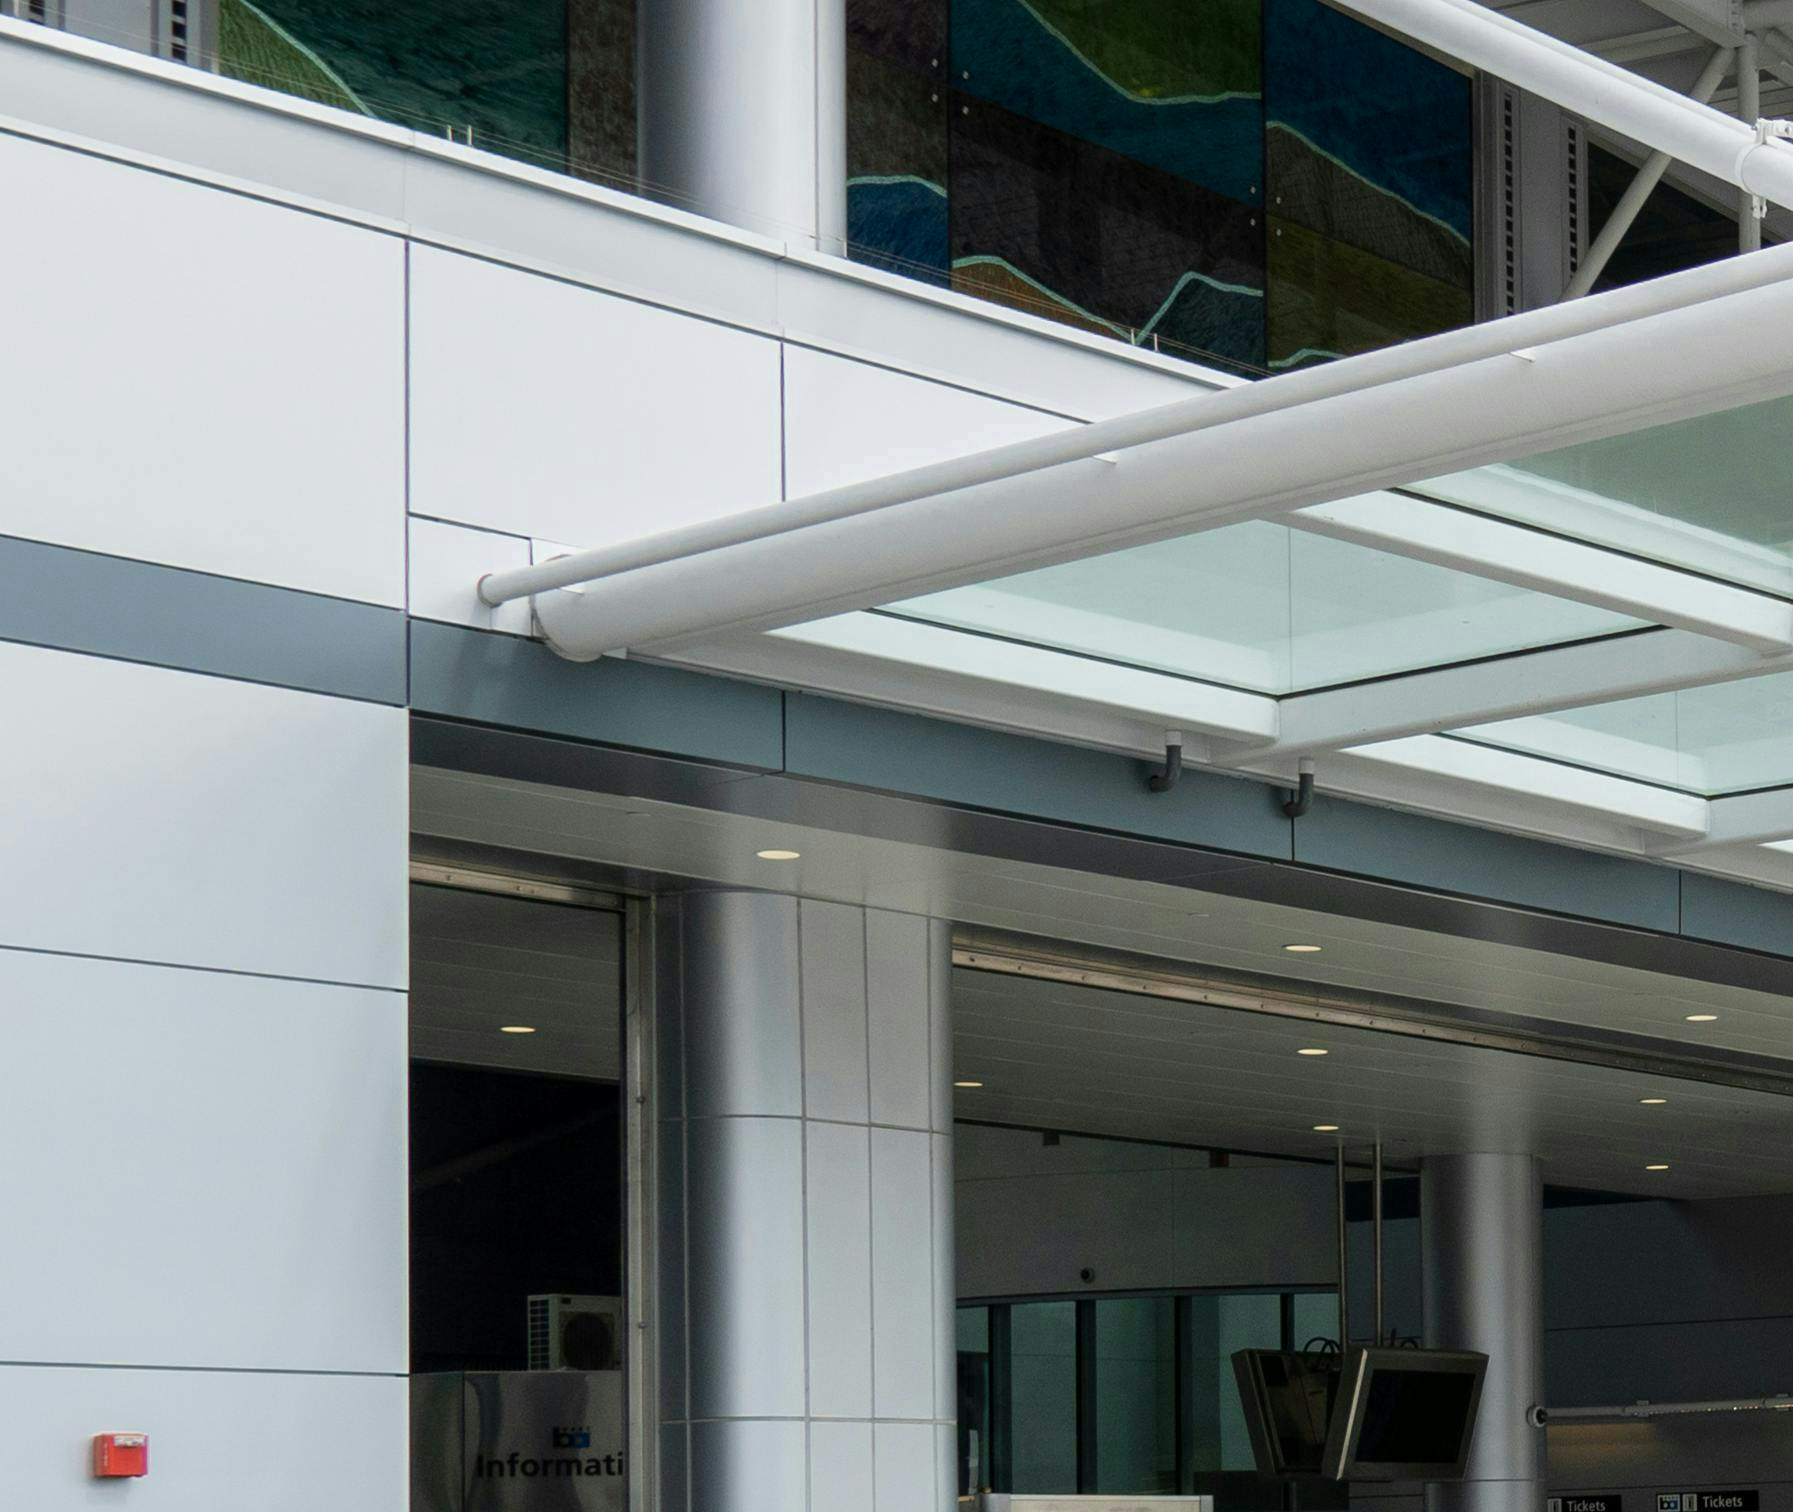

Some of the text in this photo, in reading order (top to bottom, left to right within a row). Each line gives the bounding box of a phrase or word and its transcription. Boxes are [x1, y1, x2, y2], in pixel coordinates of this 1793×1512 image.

[476, 1452, 624, 1478] Informati
[1566, 1500, 1606, 1512] Tickets
[1702, 1495, 1743, 1509] Tickets
